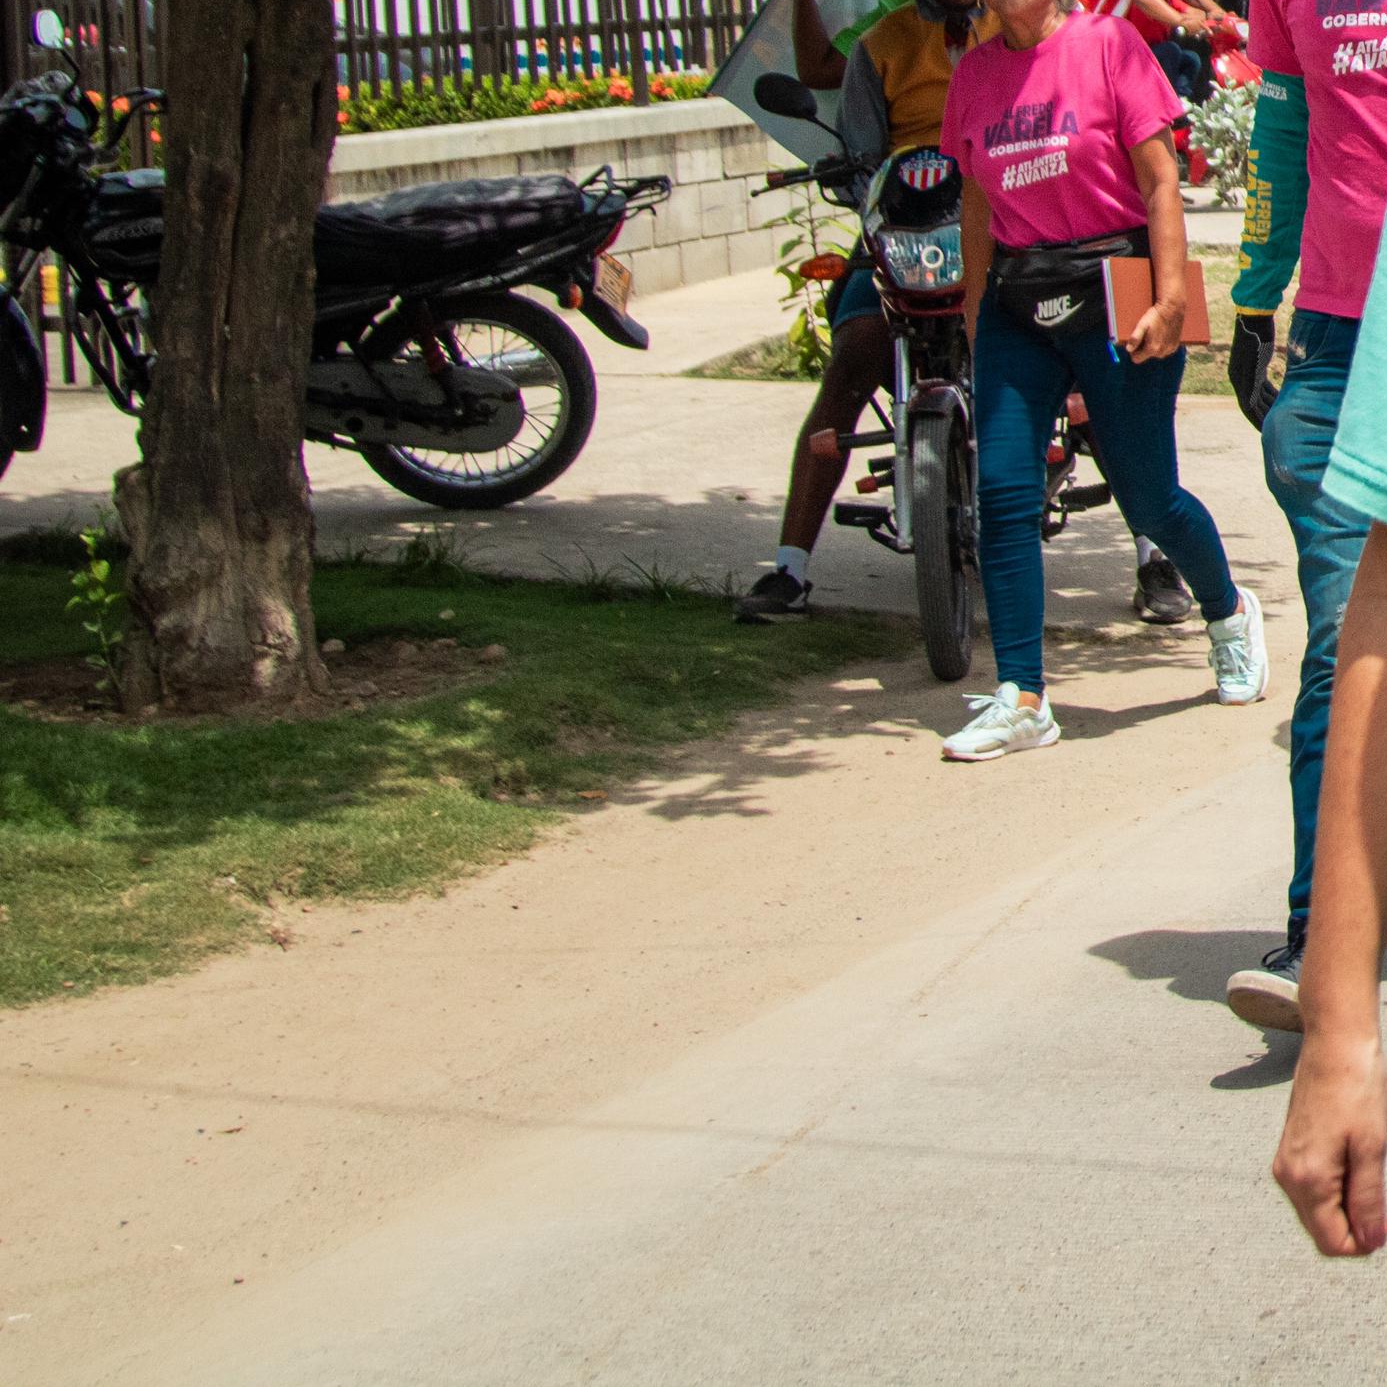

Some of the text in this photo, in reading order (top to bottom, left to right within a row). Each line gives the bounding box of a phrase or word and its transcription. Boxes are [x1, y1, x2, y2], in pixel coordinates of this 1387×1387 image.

[988, 134, 1069, 158] GOBERNADOR
[1016, 159, 1068, 188] AVANZA
[1037, 294, 1071, 319] NIKE
